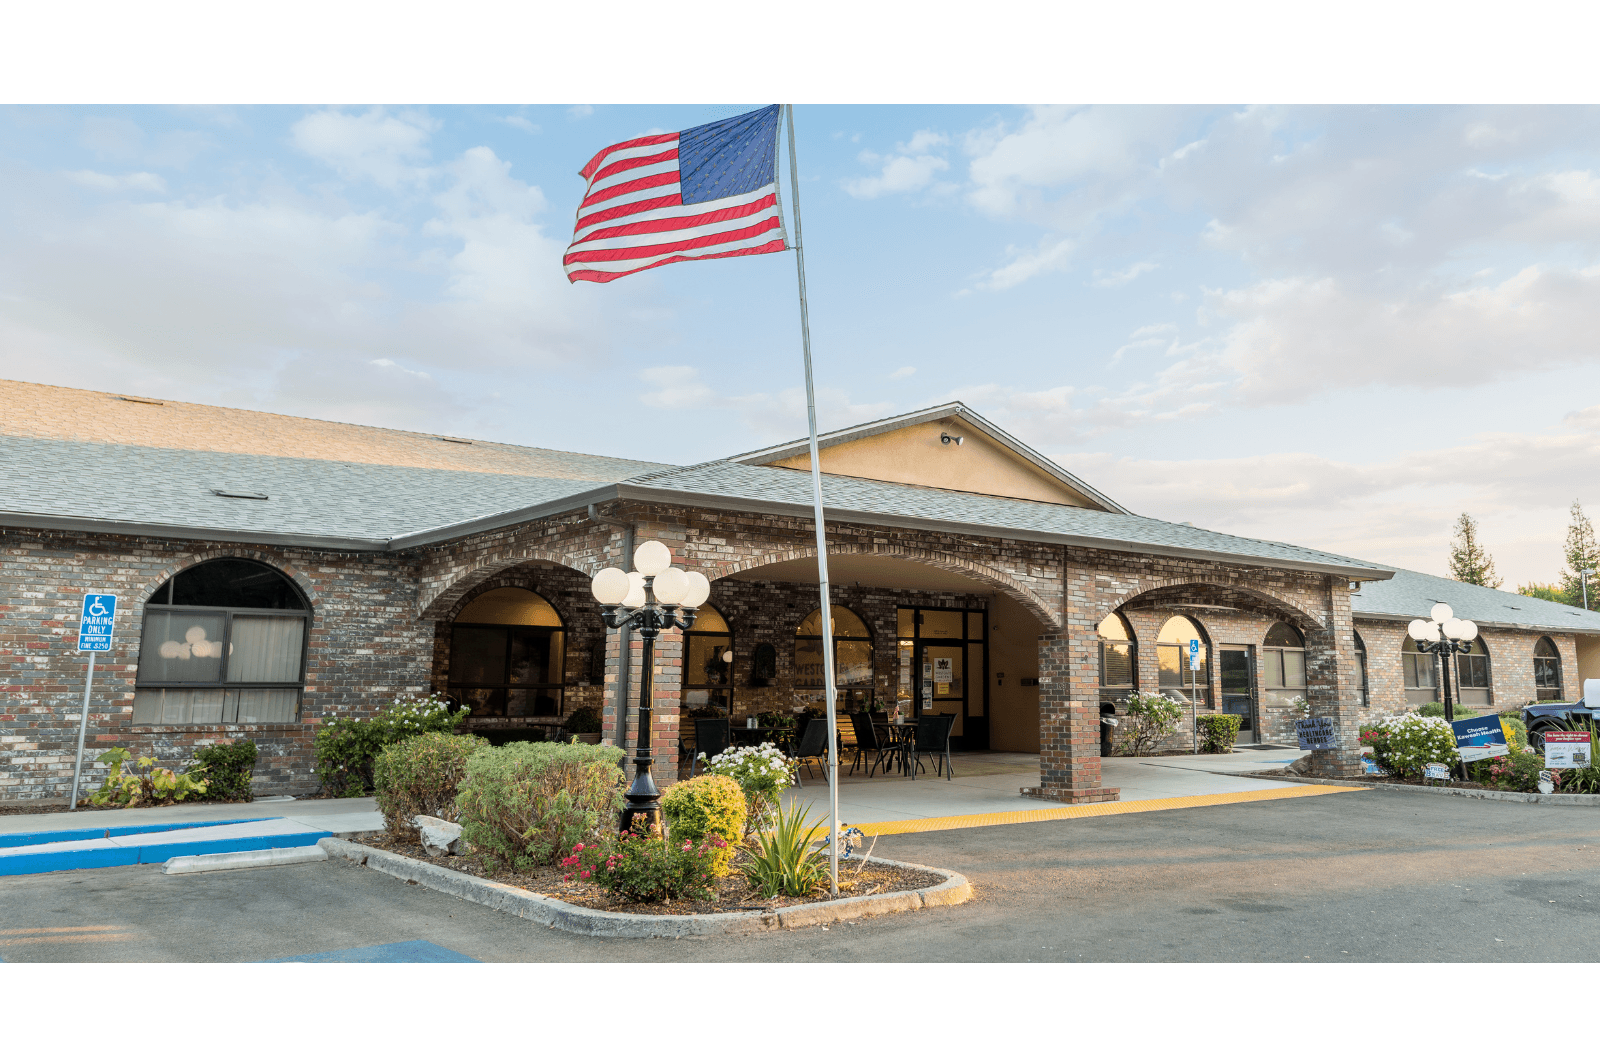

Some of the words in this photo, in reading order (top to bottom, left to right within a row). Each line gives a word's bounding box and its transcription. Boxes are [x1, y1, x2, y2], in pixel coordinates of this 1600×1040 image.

[82, 616, 113, 625] PARKING
[88, 625, 106, 634] ONLY
[1299, 730, 1332, 738] HEALTHCARE
[1457, 732, 1480, 740] Kaweah
[1480, 728, 1501, 736] Health
[1466, 726, 1489, 734] Choose
